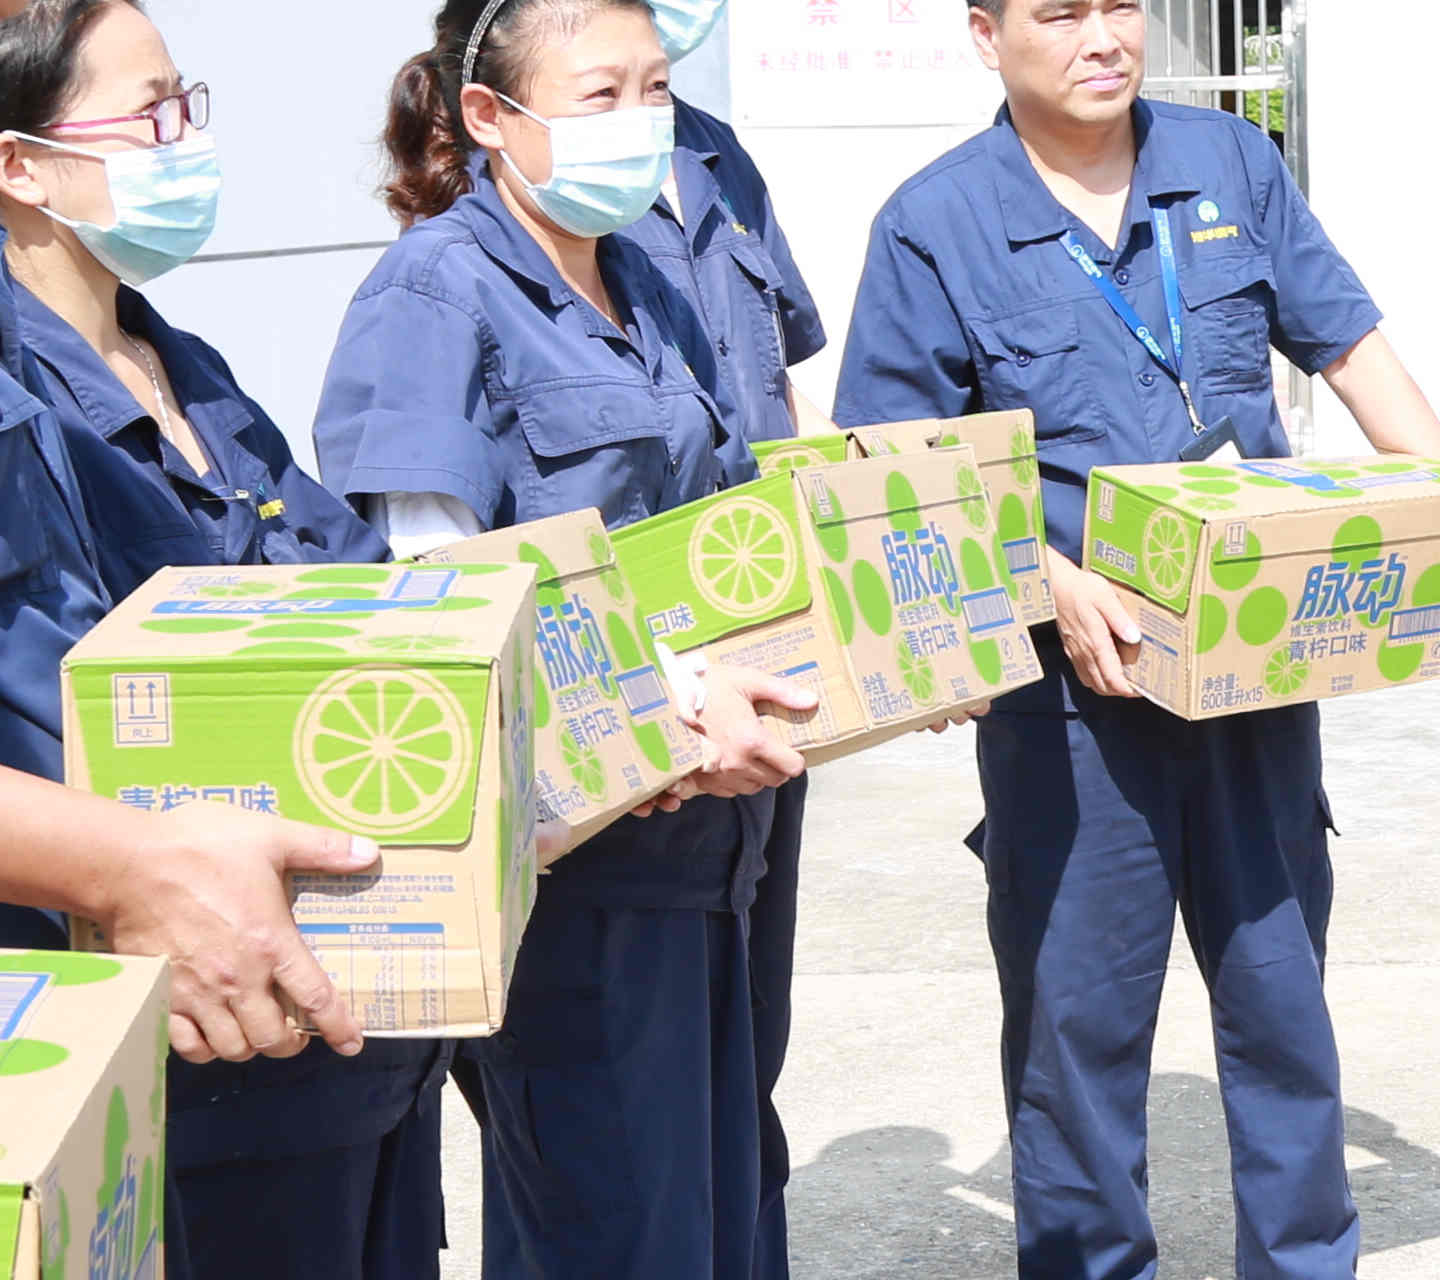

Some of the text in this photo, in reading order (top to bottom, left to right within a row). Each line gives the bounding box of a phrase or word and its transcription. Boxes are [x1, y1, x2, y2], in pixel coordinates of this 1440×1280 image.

[881, 521, 960, 611] 脉动
[1095, 538, 1138, 574] 青柠口味
[1292, 553, 1408, 624] 脉动
[646, 603, 695, 637] 口味
[1290, 618, 1352, 638] 维生素饮料
[536, 593, 612, 694] 脉动
[904, 622, 961, 657] 青柠口味
[1288, 632, 1369, 663] 青柠口味
[566, 707, 625, 751] 青柠口味
